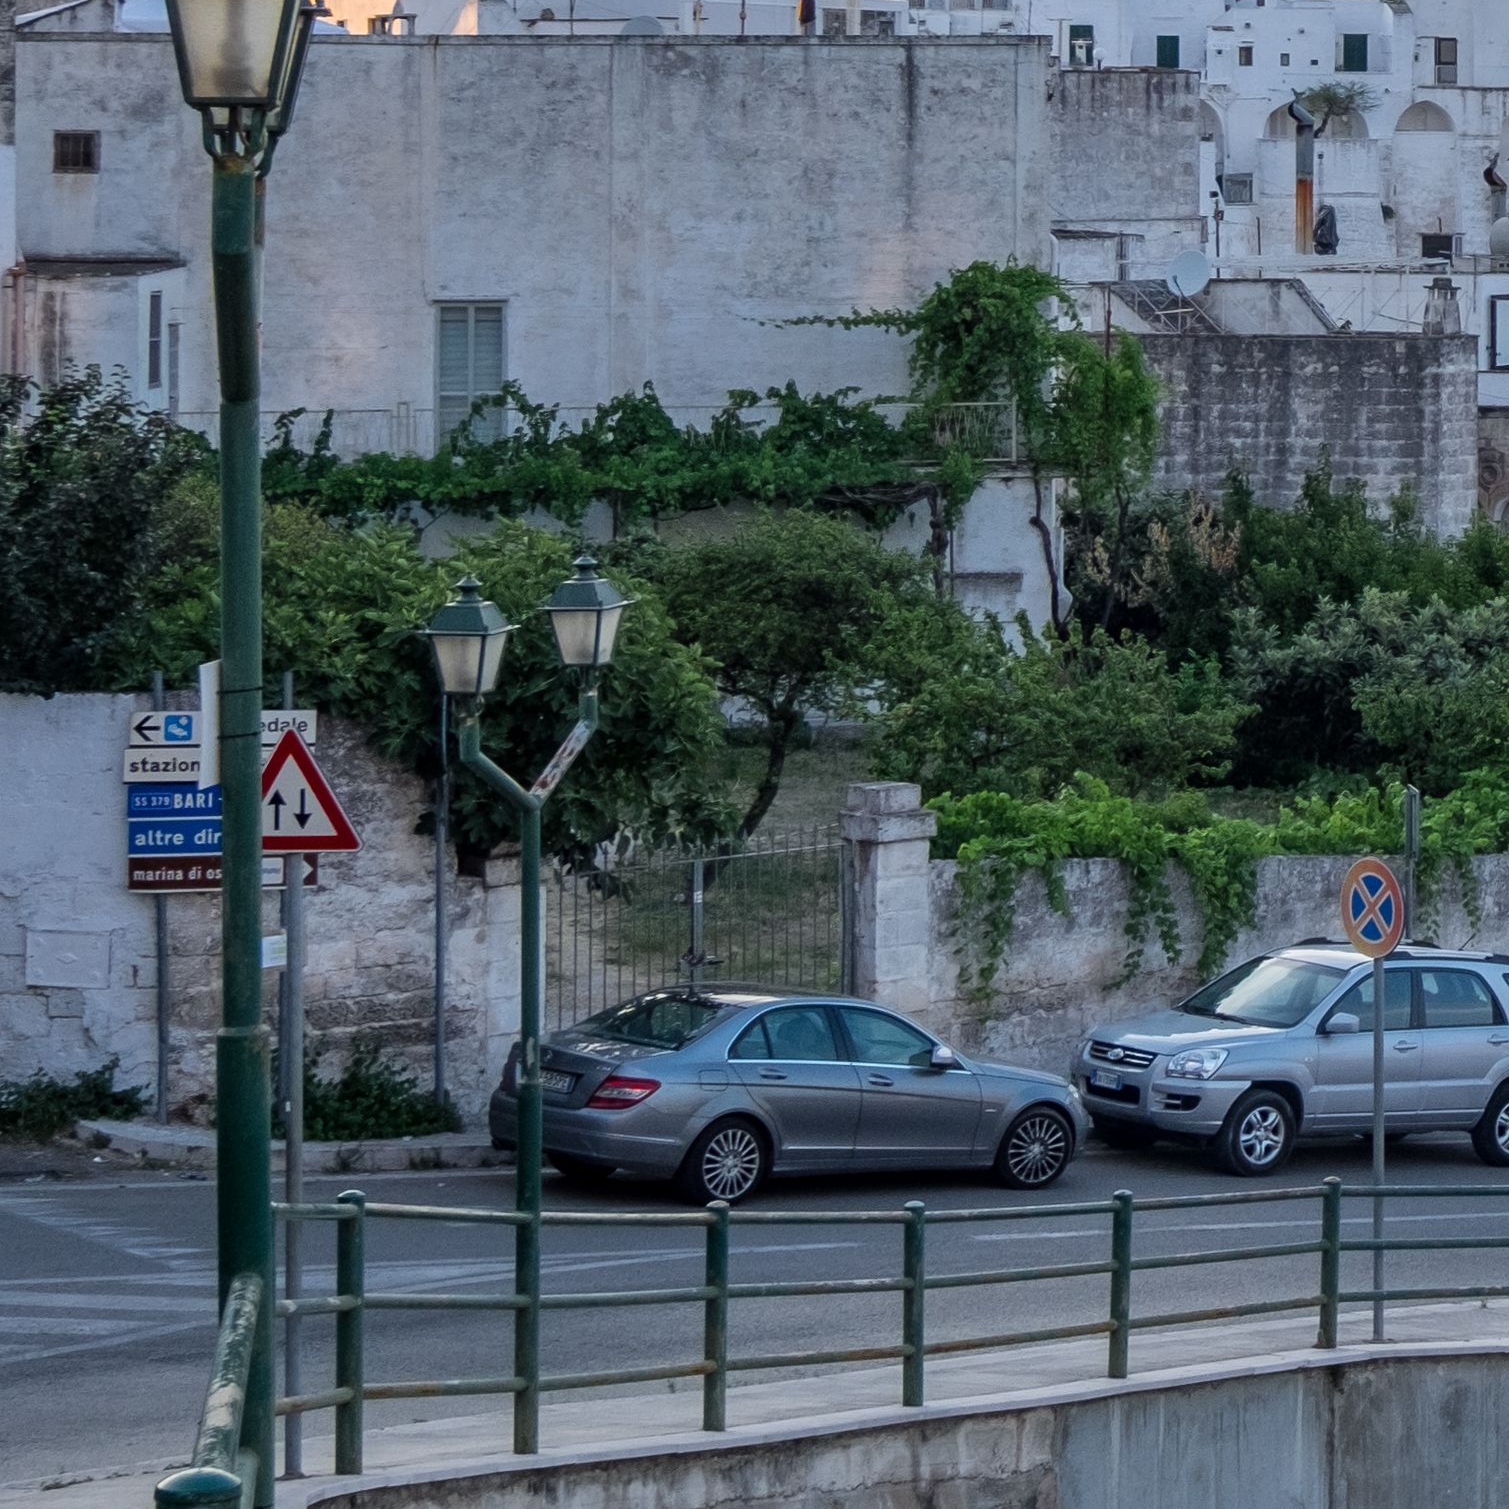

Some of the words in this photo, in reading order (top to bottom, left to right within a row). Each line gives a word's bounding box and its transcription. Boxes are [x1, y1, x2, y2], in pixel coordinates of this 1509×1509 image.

[260, 718, 308, 733] edale
[129, 757, 200, 773] stazion
[134, 794, 147, 806] SS
[150, 793, 170, 806] 379
[173, 793, 213, 809] BARI
[134, 830, 184, 846] altre
[194, 829, 222, 845] dir
[132, 868, 183, 881] marina
[187, 866, 202, 879] di
[206, 869, 222, 879] os
